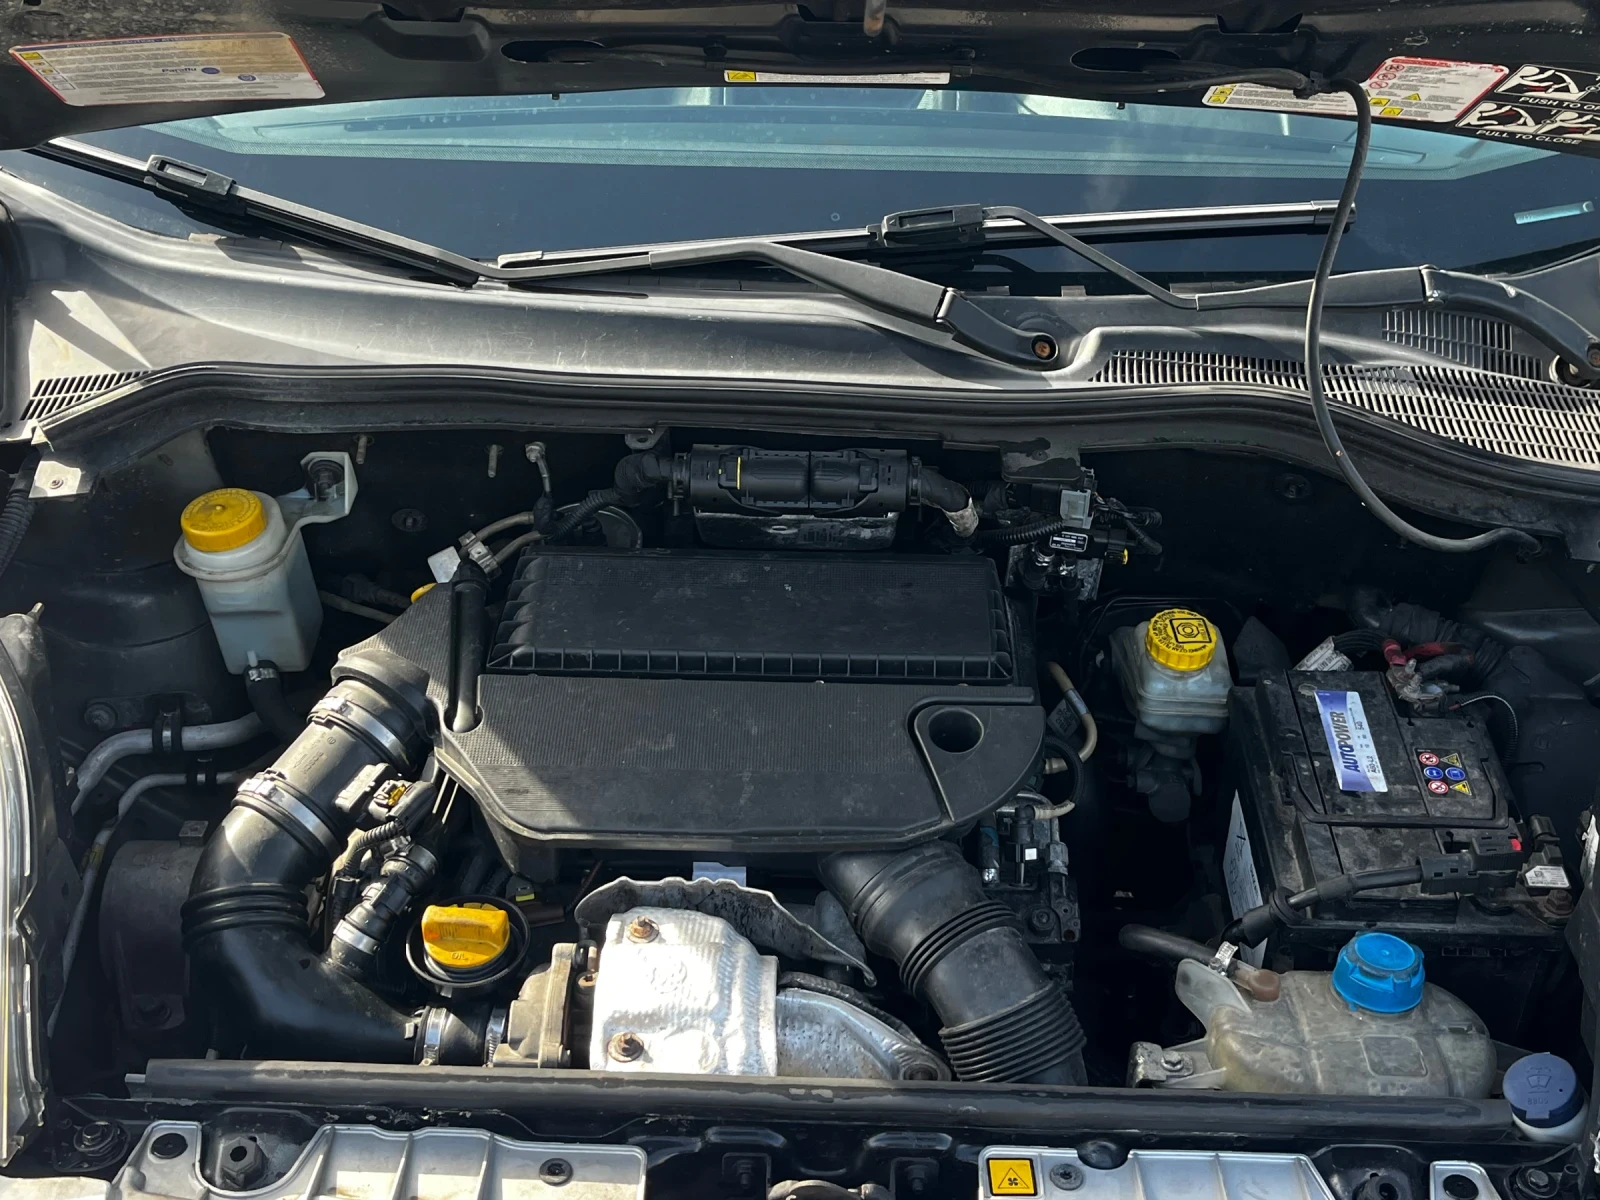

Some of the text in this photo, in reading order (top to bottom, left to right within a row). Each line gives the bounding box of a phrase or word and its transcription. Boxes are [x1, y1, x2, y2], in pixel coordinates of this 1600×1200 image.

[1519, 97, 1559, 106] PUSH
[1562, 101, 1581, 109] TO
[1476, 129, 1510, 138] PULL
[1535, 136, 1582, 145] CLOSE
[1330, 711, 1361, 773] AUTOPOWER
